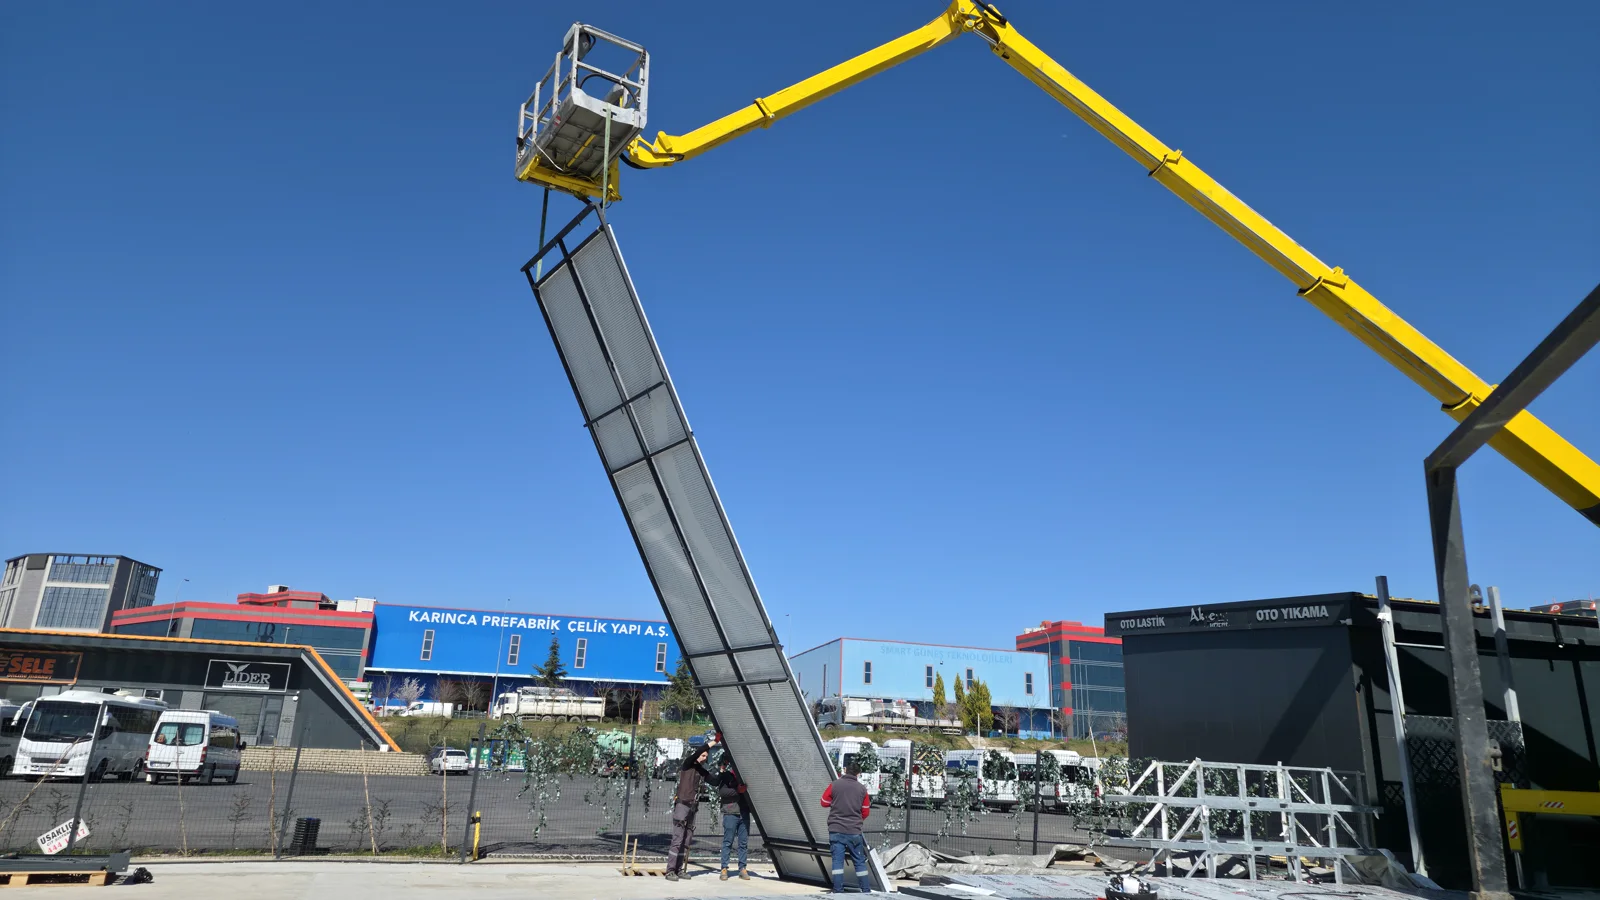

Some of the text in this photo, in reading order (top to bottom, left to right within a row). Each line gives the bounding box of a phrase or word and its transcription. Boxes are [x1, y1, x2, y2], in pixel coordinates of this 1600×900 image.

[1256, 605, 1329, 621] OTO YIKAMA
[409, 610, 669, 638] KARINCA PREFABRİK ÇELİK YAPI A.Ş.
[1120, 615, 1166, 629] OTO LASTİK
[880, 643, 913, 656] SMART
